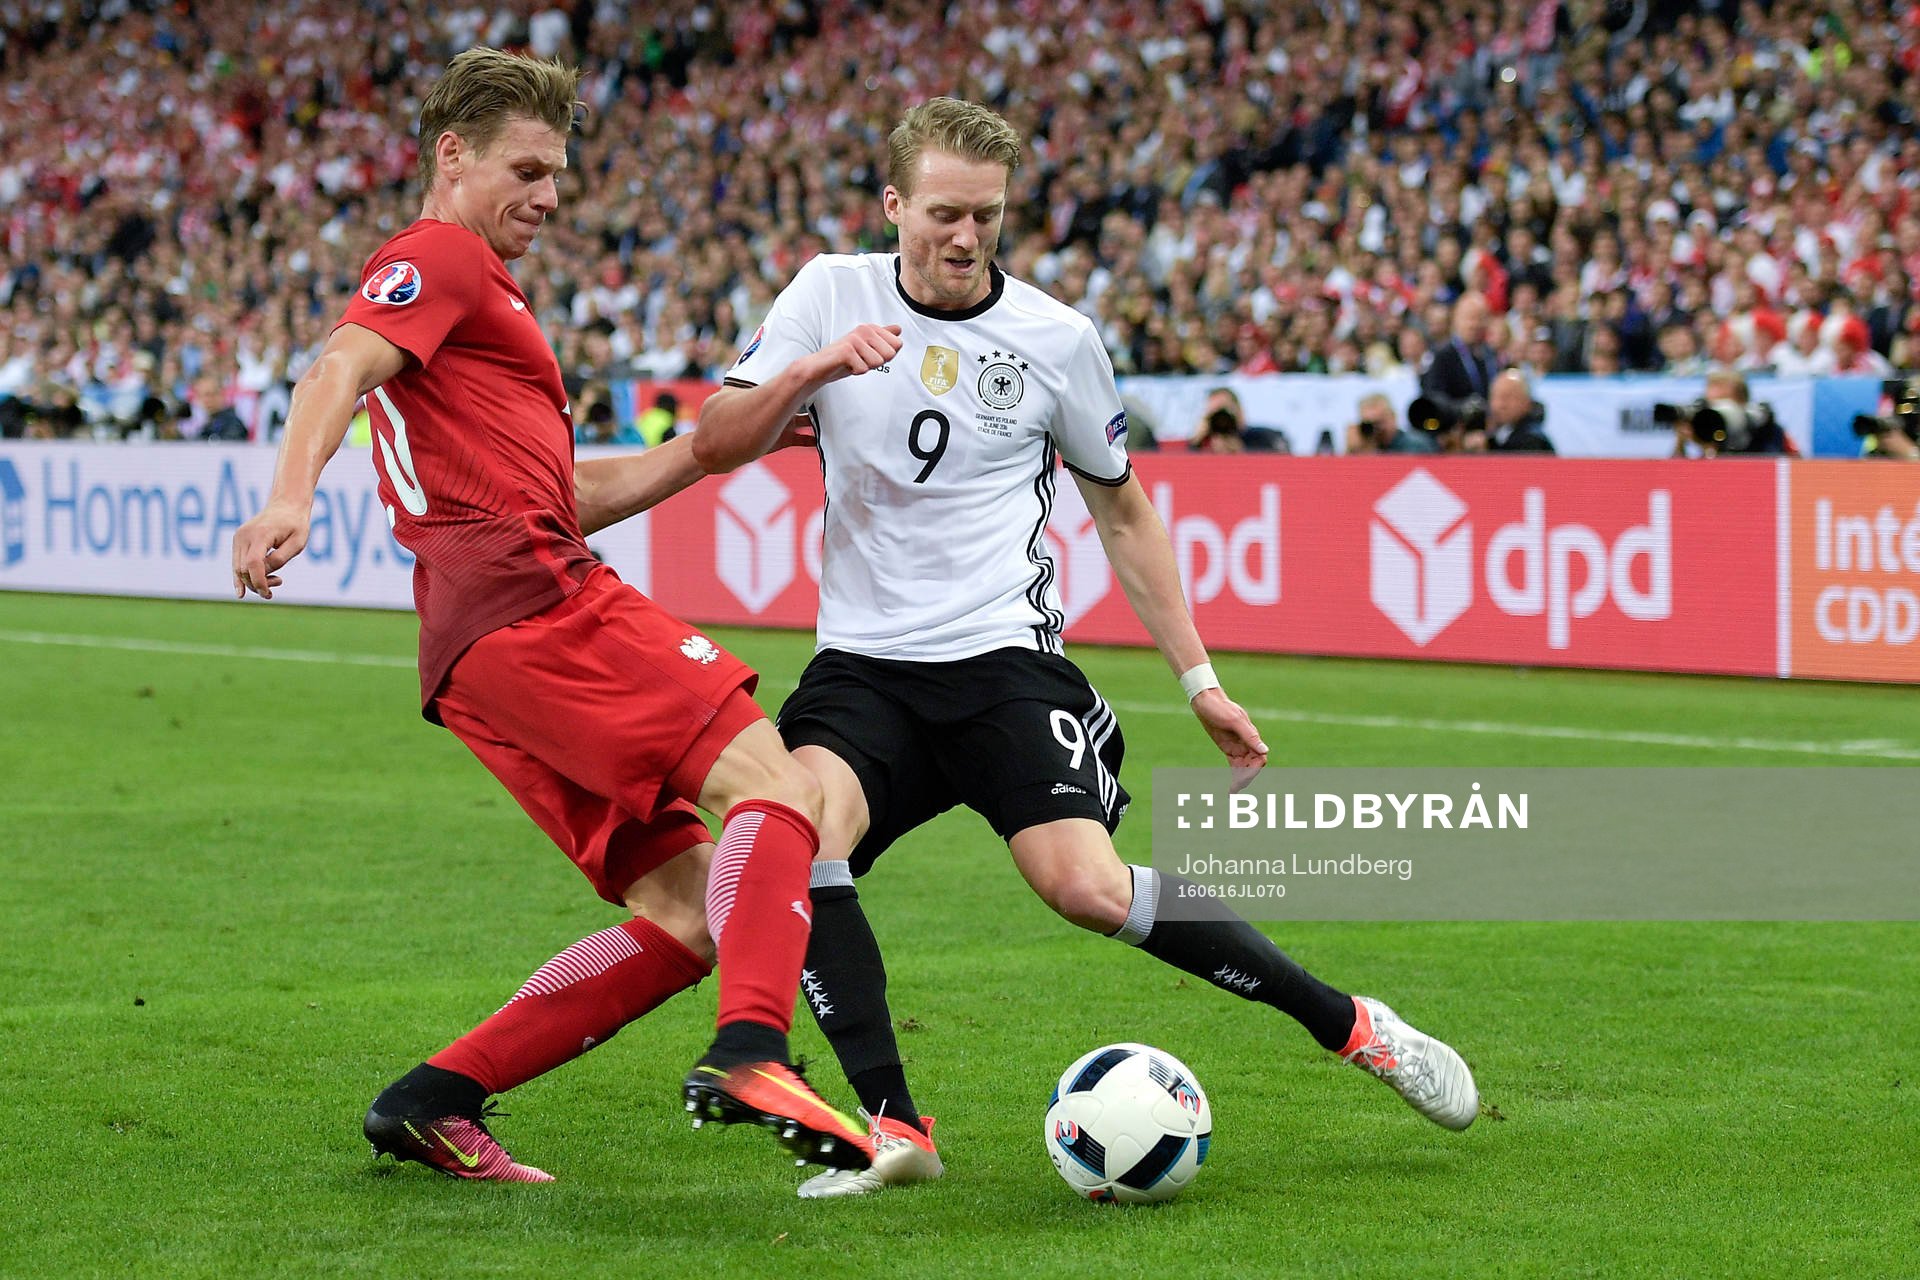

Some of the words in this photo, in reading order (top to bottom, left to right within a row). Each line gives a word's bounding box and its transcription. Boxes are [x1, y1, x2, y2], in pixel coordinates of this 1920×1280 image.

[929, 376, 949, 387] FIFA
[908, 409, 950, 484] 9
[44, 456, 413, 592] HomeAay.
[1153, 481, 1282, 622] pd
[1484, 486, 1673, 650] dpd
[1049, 709, 1086, 770] 9
